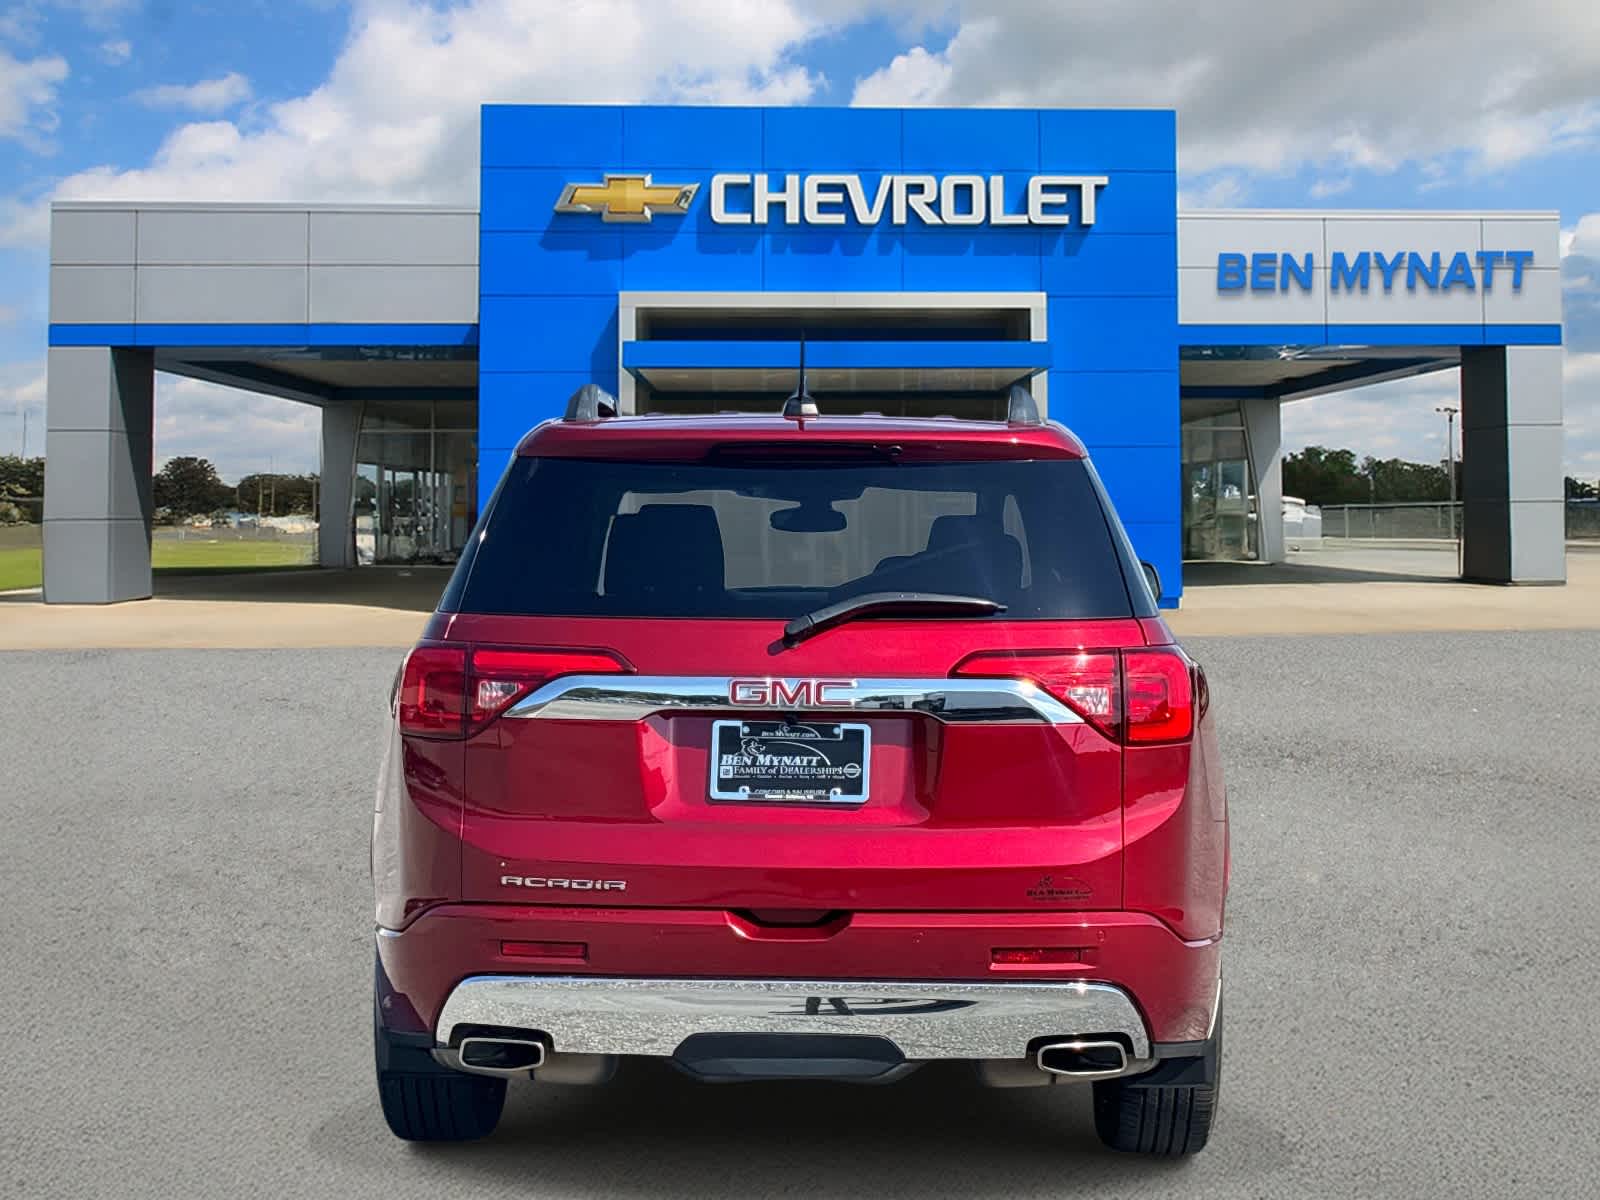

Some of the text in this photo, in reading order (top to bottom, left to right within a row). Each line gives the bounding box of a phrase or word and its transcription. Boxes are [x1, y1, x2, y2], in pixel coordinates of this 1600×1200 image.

[710, 173, 1109, 225] CHEVROLET
[1216, 250, 1534, 291] BEN MYNATT
[729, 677, 858, 708] GMC
[720, 754, 821, 766] BEN MYNATT
[734, 766, 768, 775] FAMILY
[780, 765, 842, 775] DEALERSHIPS
[501, 875, 627, 891] ACADIA
